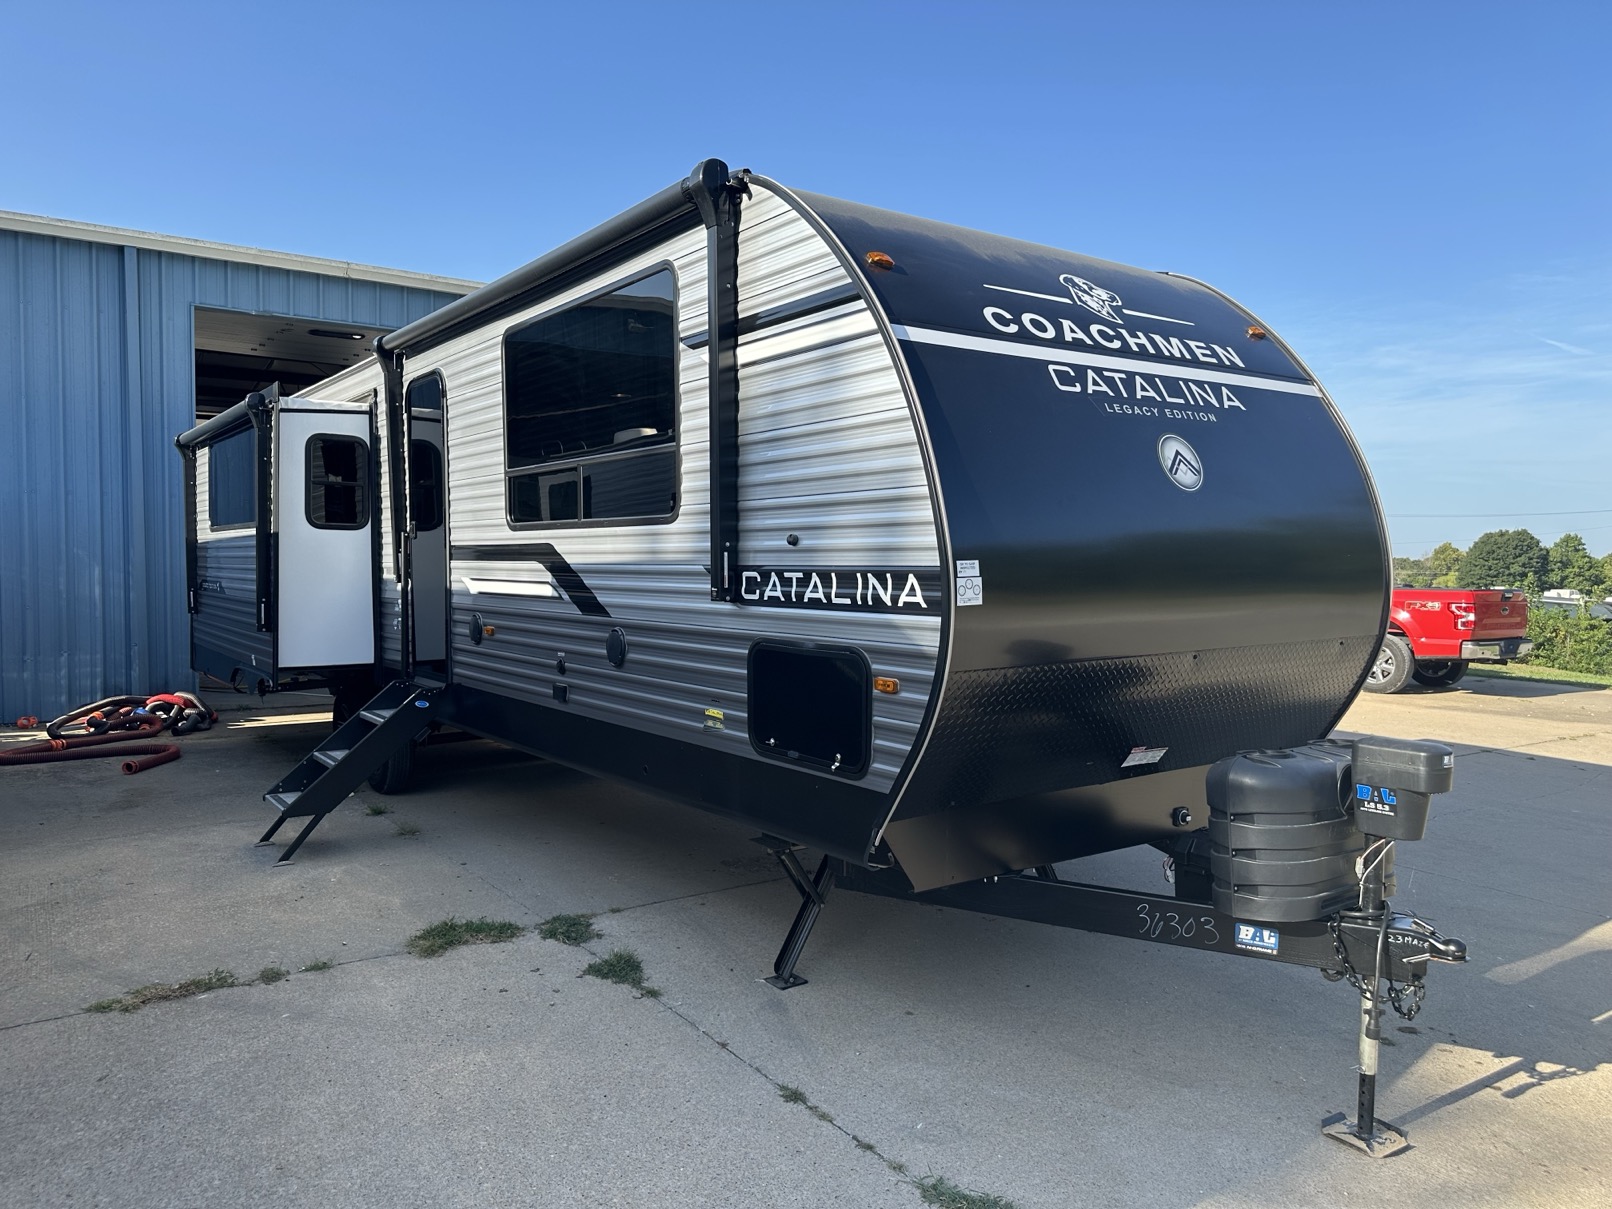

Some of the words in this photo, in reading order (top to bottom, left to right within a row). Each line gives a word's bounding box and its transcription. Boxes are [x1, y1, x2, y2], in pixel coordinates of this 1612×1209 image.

[982, 305, 1246, 368] COACHMEN
[1047, 363, 1247, 411] CATALINA
[1104, 402, 1159, 417] LEGACY
[1164, 408, 1217, 422] EDITION
[741, 571, 928, 608] CATALINA
[1404, 600, 1441, 611] FX4
[1136, 903, 1220, 945] 36303
[1238, 925, 1276, 944] BAL
